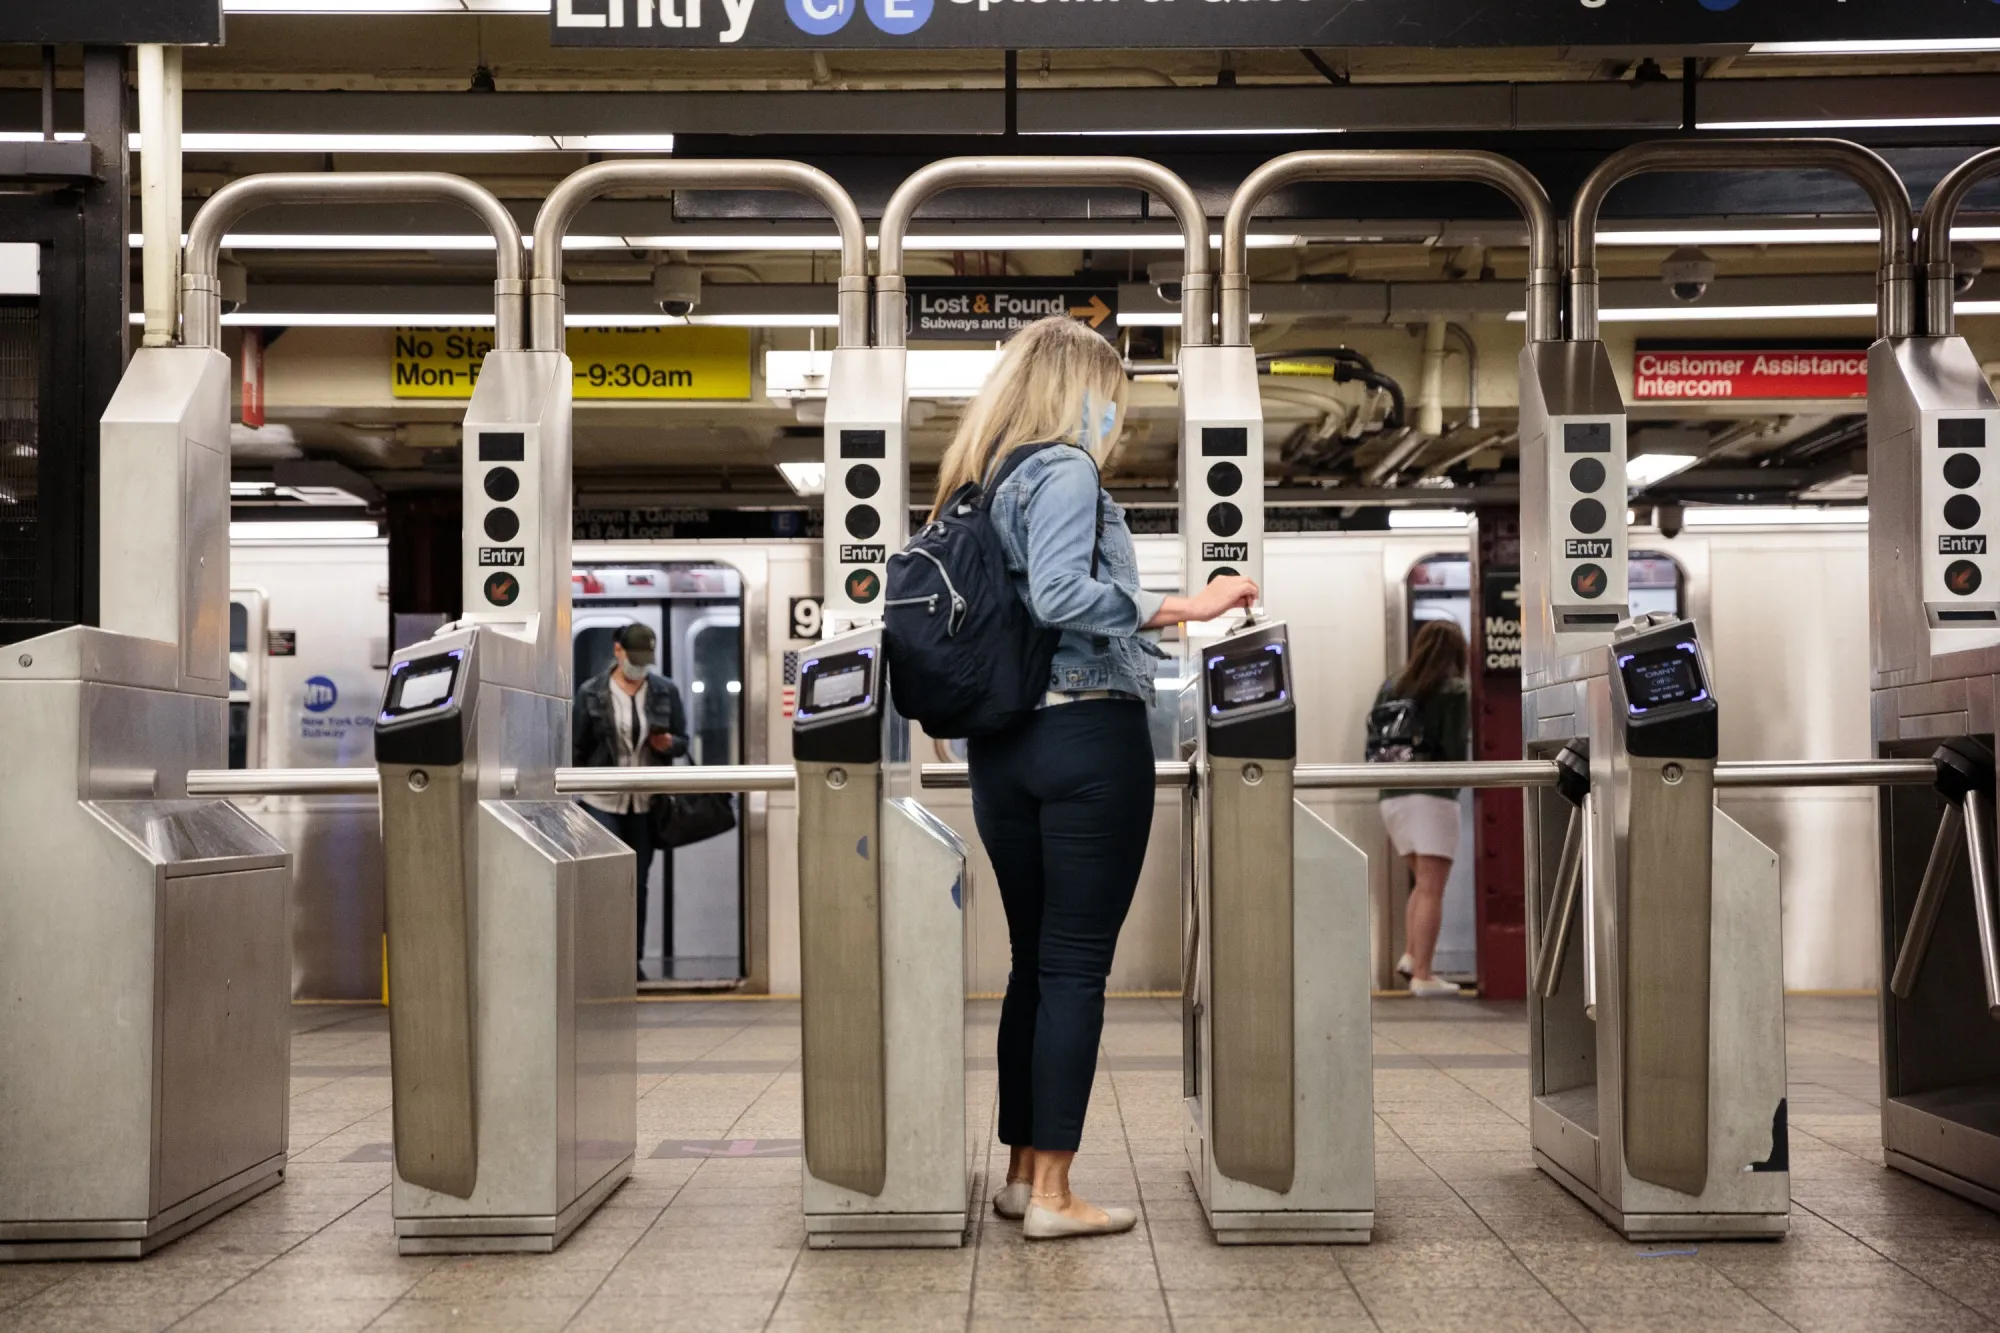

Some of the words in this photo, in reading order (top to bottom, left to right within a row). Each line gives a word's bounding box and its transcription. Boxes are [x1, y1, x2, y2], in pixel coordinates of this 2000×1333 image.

[921, 294, 969, 314] Lost
[973, 294, 990, 314] &
[995, 294, 1064, 314] Found
[921, 316, 979, 332] Subways
[981, 317, 1006, 329] and
[396, 335, 433, 358] No
[445, 334, 493, 358] Sta
[1639, 355, 1744, 375] Customer
[1752, 355, 1867, 375] Assistance
[396, 363, 484, 385] Mon-F
[572, 364, 692, 387] -9:30am
[1638, 376, 1732, 396] Intercom
[778, 514, 791, 531] E
[841, 545, 883, 563] Entry
[1203, 543, 1246, 560] Entry
[1566, 540, 1610, 557] Entry
[1940, 536, 1984, 554] Entry
[480, 548, 523, 566] Entry
[794, 599, 823, 637] 9
[1486, 616, 1521, 635] Mov
[1487, 635, 1521, 651] tow
[1487, 653, 1521, 669] cen
